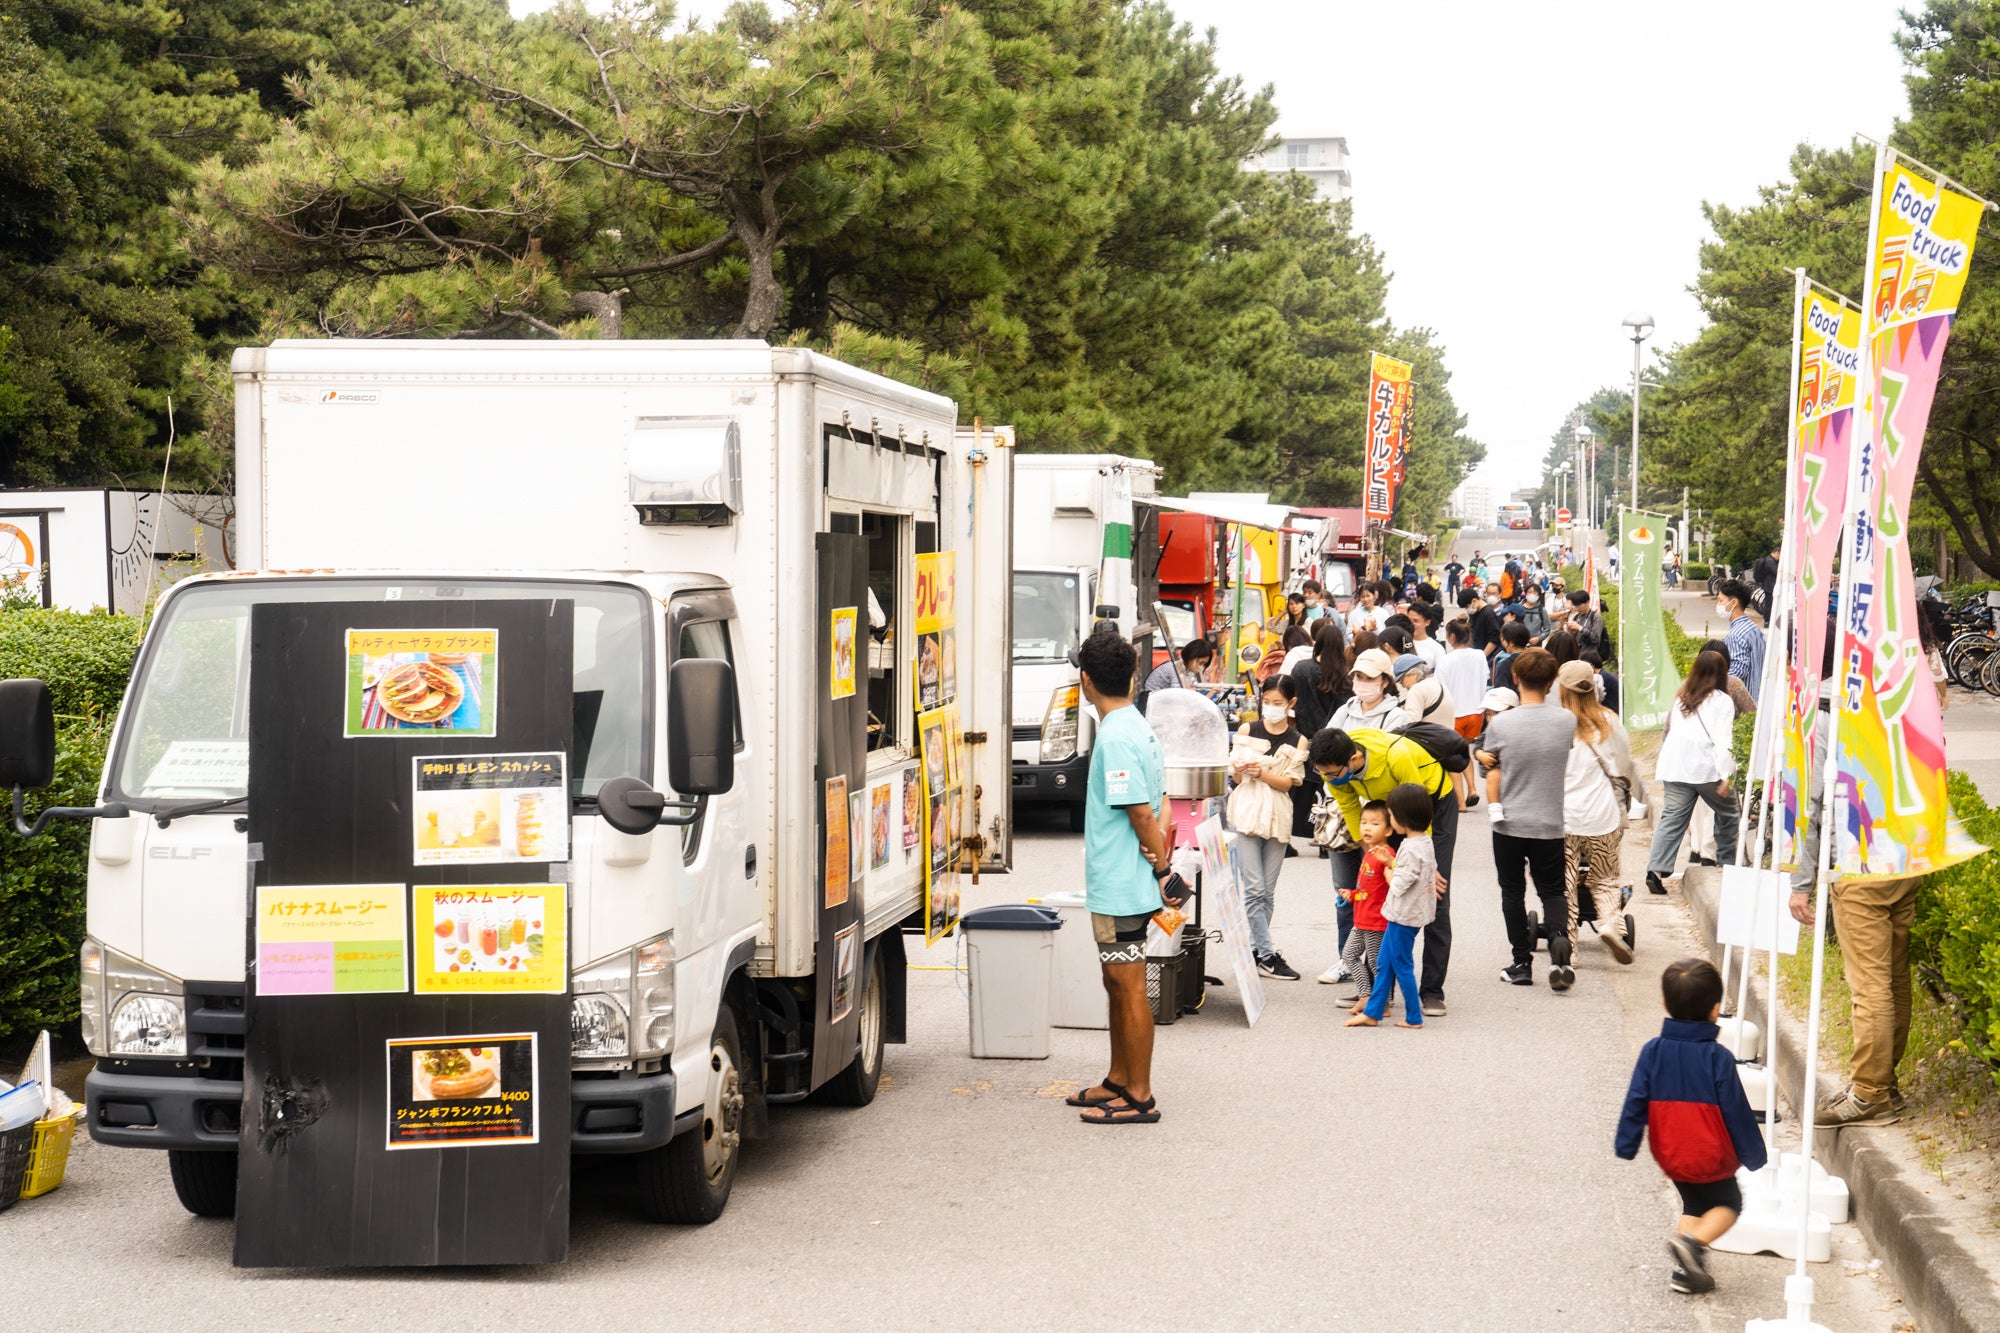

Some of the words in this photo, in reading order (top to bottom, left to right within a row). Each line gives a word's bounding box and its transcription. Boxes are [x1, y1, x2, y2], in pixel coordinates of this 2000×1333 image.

[1892, 181, 1936, 226] Food
[1913, 229, 1961, 268] truck
[1809, 304, 1840, 337] Food
[1826, 340, 1859, 371] truck
[1368, 382, 1394, 513] 牛カルビ重
[1873, 370, 1920, 815] スムージー
[351, 636, 492, 649] トルティーヤラップサンド
[423, 763, 453, 775] 手作り
[456, 762, 498, 774] 生レモン
[501, 761, 552, 772] スカッシュ
[149, 847, 211, 860] ELF
[434, 890, 539, 905] 秋のスムージー
[269, 901, 388, 916] バナナスムージー
[501, 1091, 530, 1101] ¥400
[397, 1104, 514, 1119] ジャンボフランクフルト
